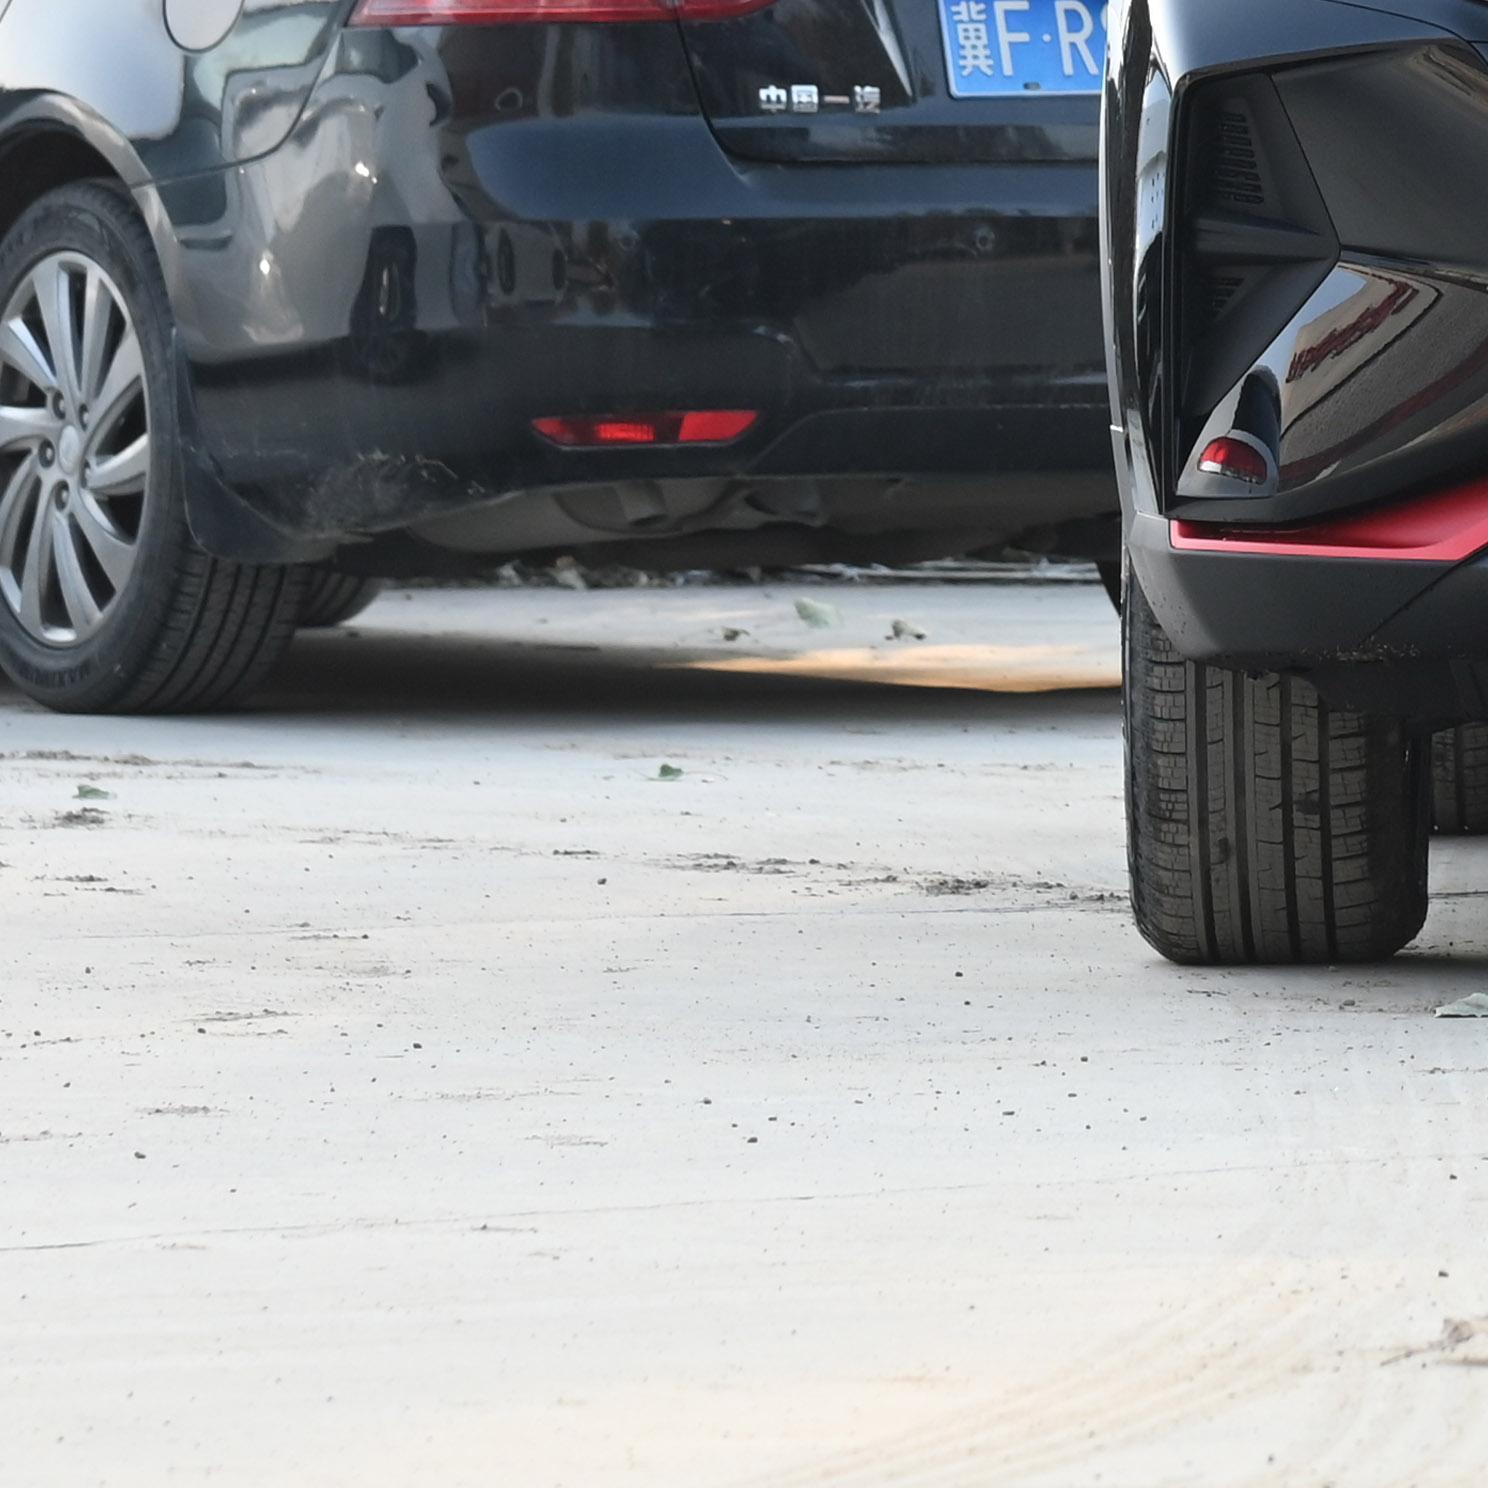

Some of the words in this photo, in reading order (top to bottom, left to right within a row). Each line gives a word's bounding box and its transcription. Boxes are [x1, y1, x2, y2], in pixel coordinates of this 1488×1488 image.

[951, 0, 1108, 77] 冀F·R
[758, 84, 881, 114] 中国一汽
